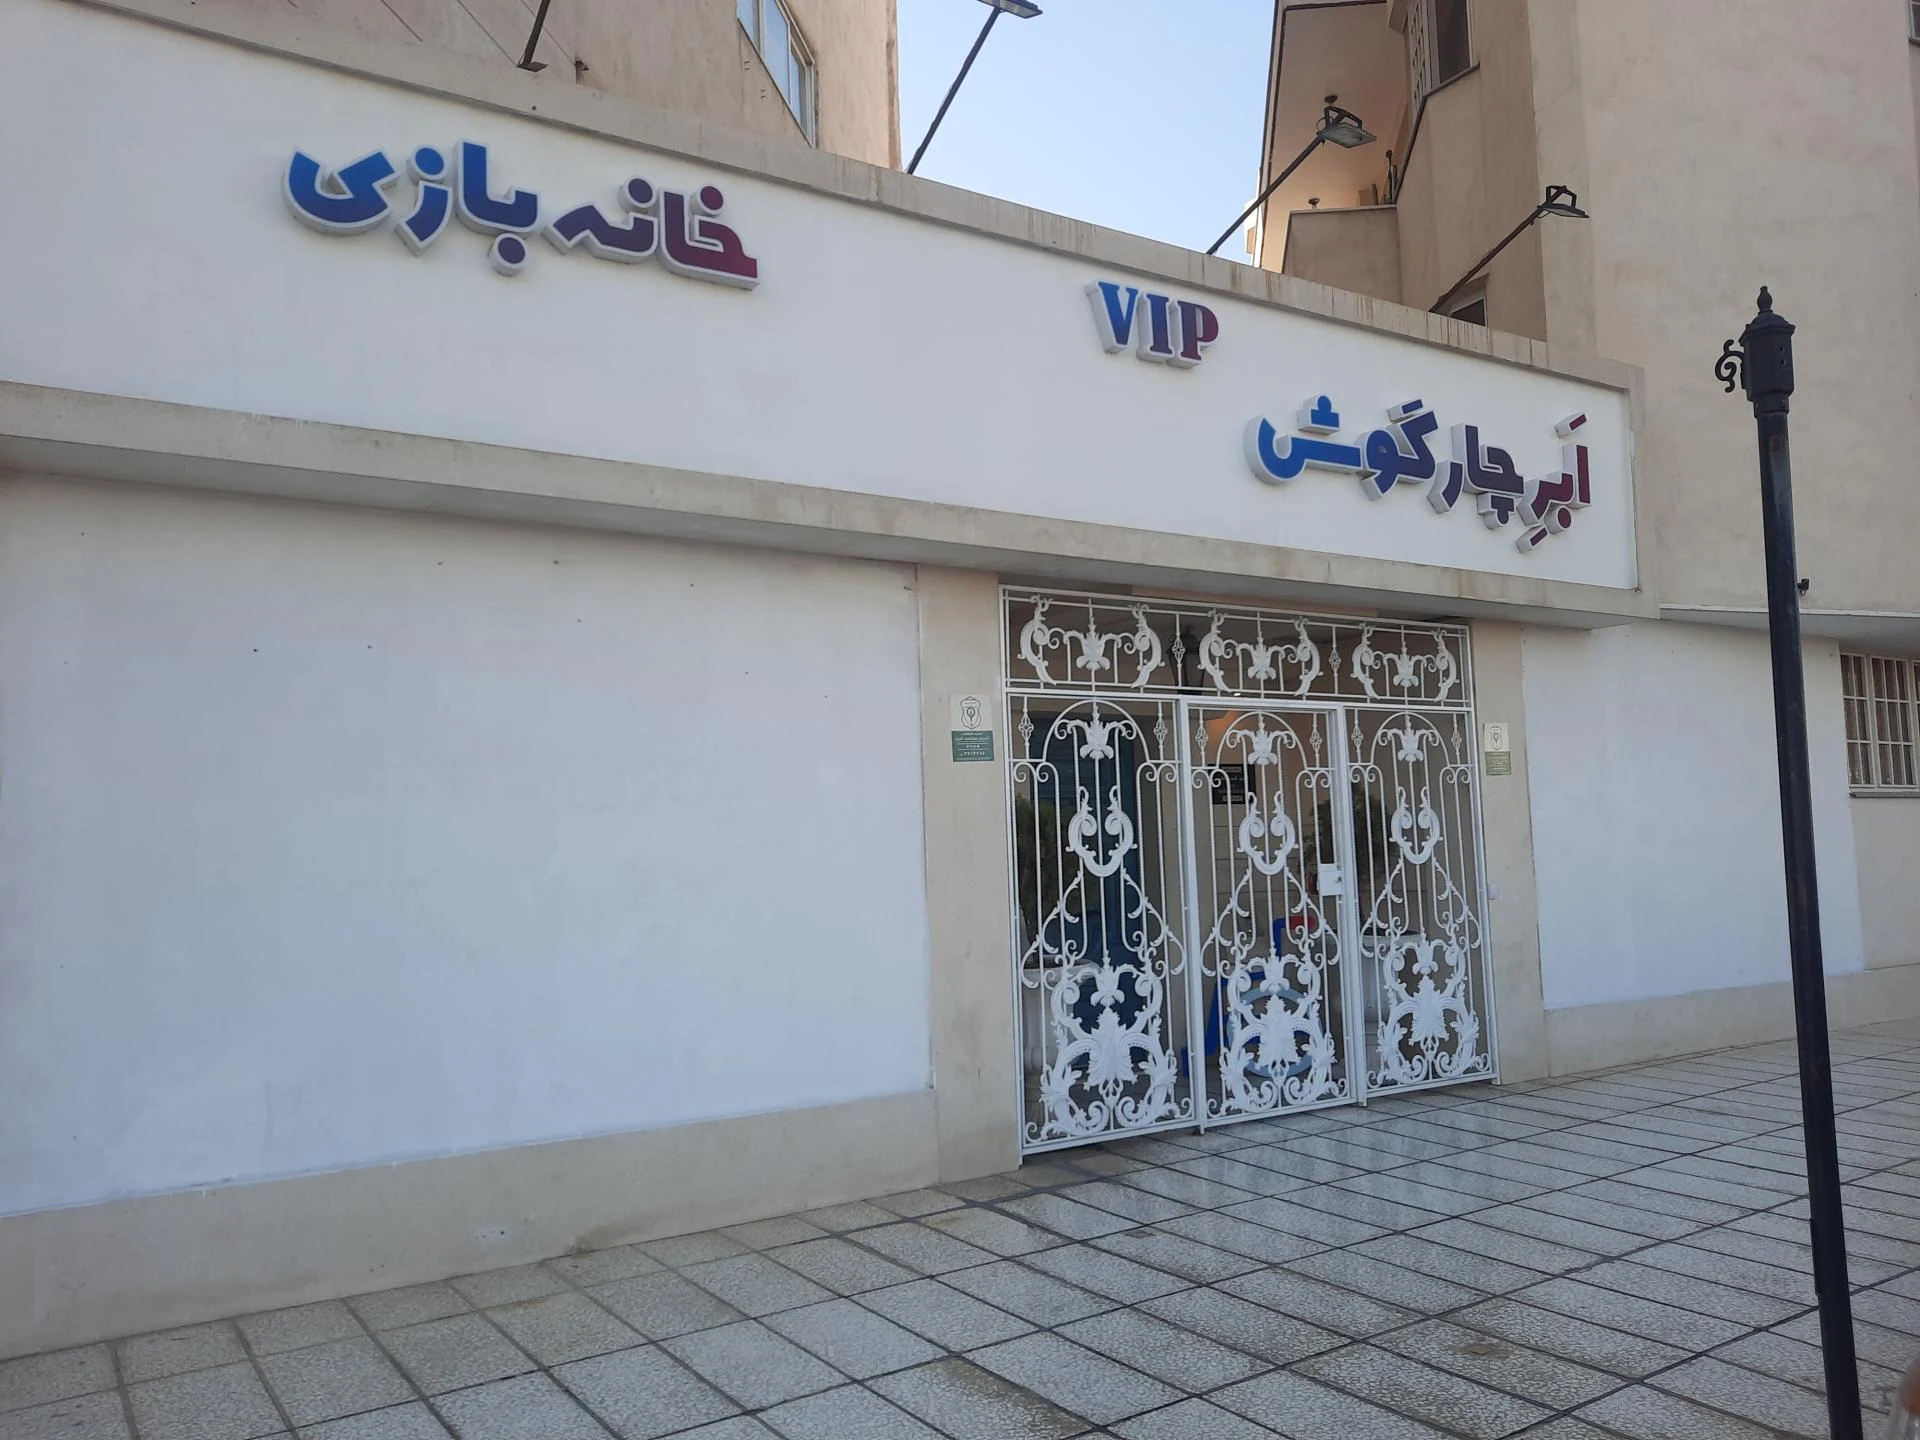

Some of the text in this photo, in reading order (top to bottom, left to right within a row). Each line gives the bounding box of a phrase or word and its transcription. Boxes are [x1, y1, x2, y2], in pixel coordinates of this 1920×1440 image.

[284, 138, 760, 287] خانه بازی
[1090, 279, 1221, 365] VIP
